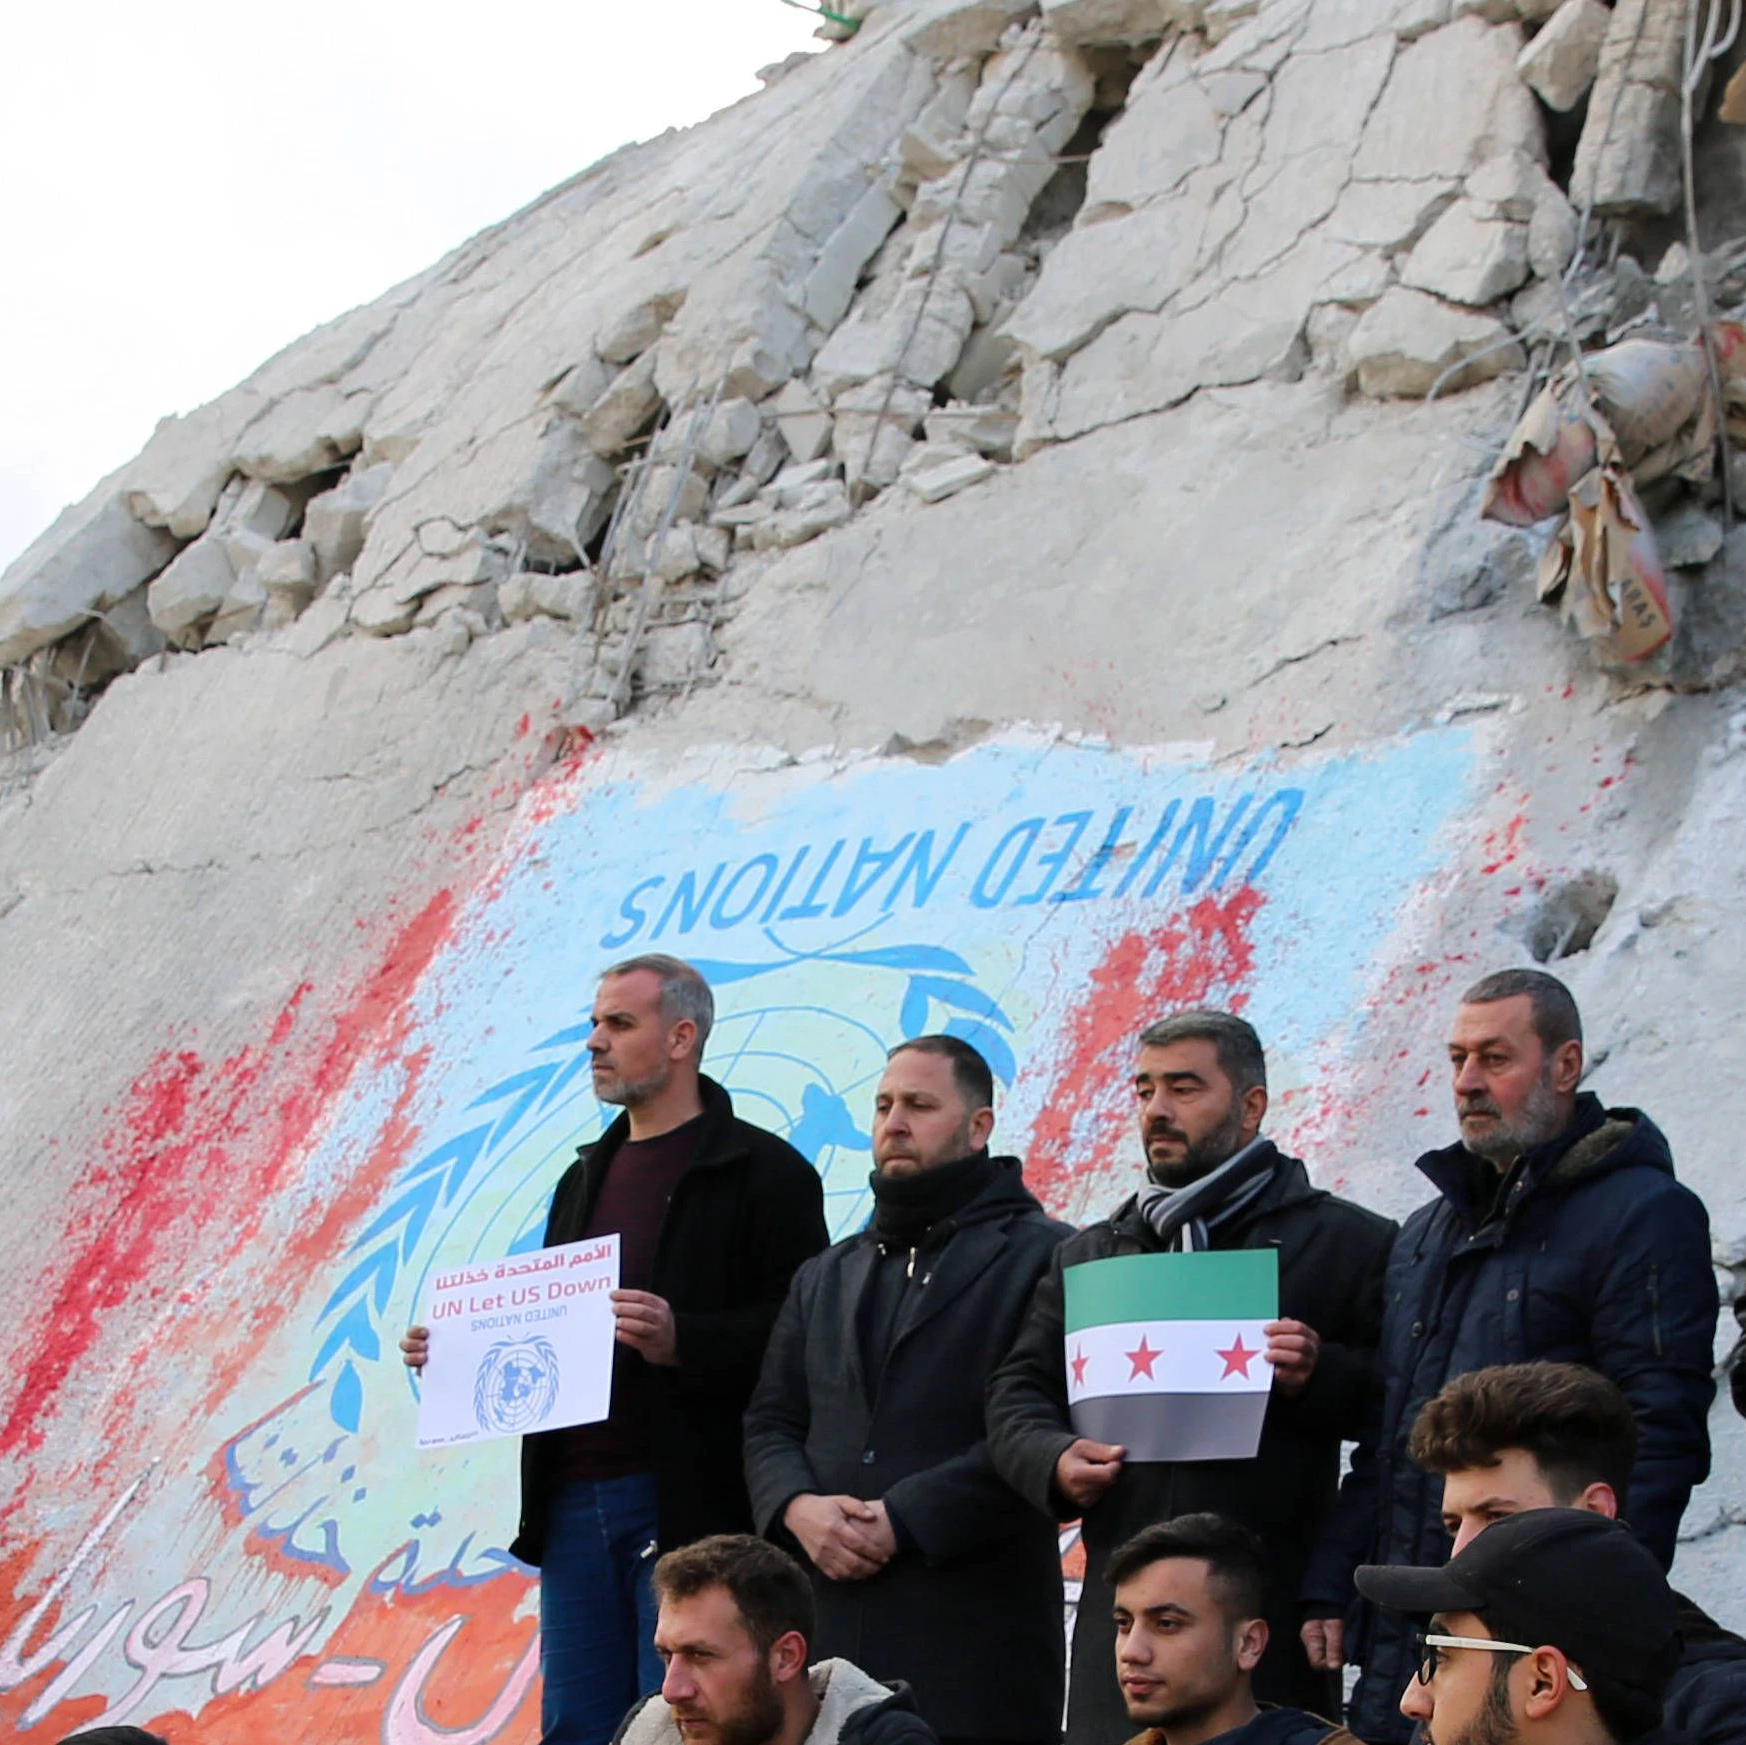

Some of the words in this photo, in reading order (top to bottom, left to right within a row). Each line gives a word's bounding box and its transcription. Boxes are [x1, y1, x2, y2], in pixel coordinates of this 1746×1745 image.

[599, 820, 971, 949] NATIONS
[969, 787, 1305, 910] UNITED
[432, 1299, 463, 1320] UN
[469, 1294, 505, 1313] Let
[511, 1285, 541, 1306] US
[547, 1275, 612, 1300] Down
